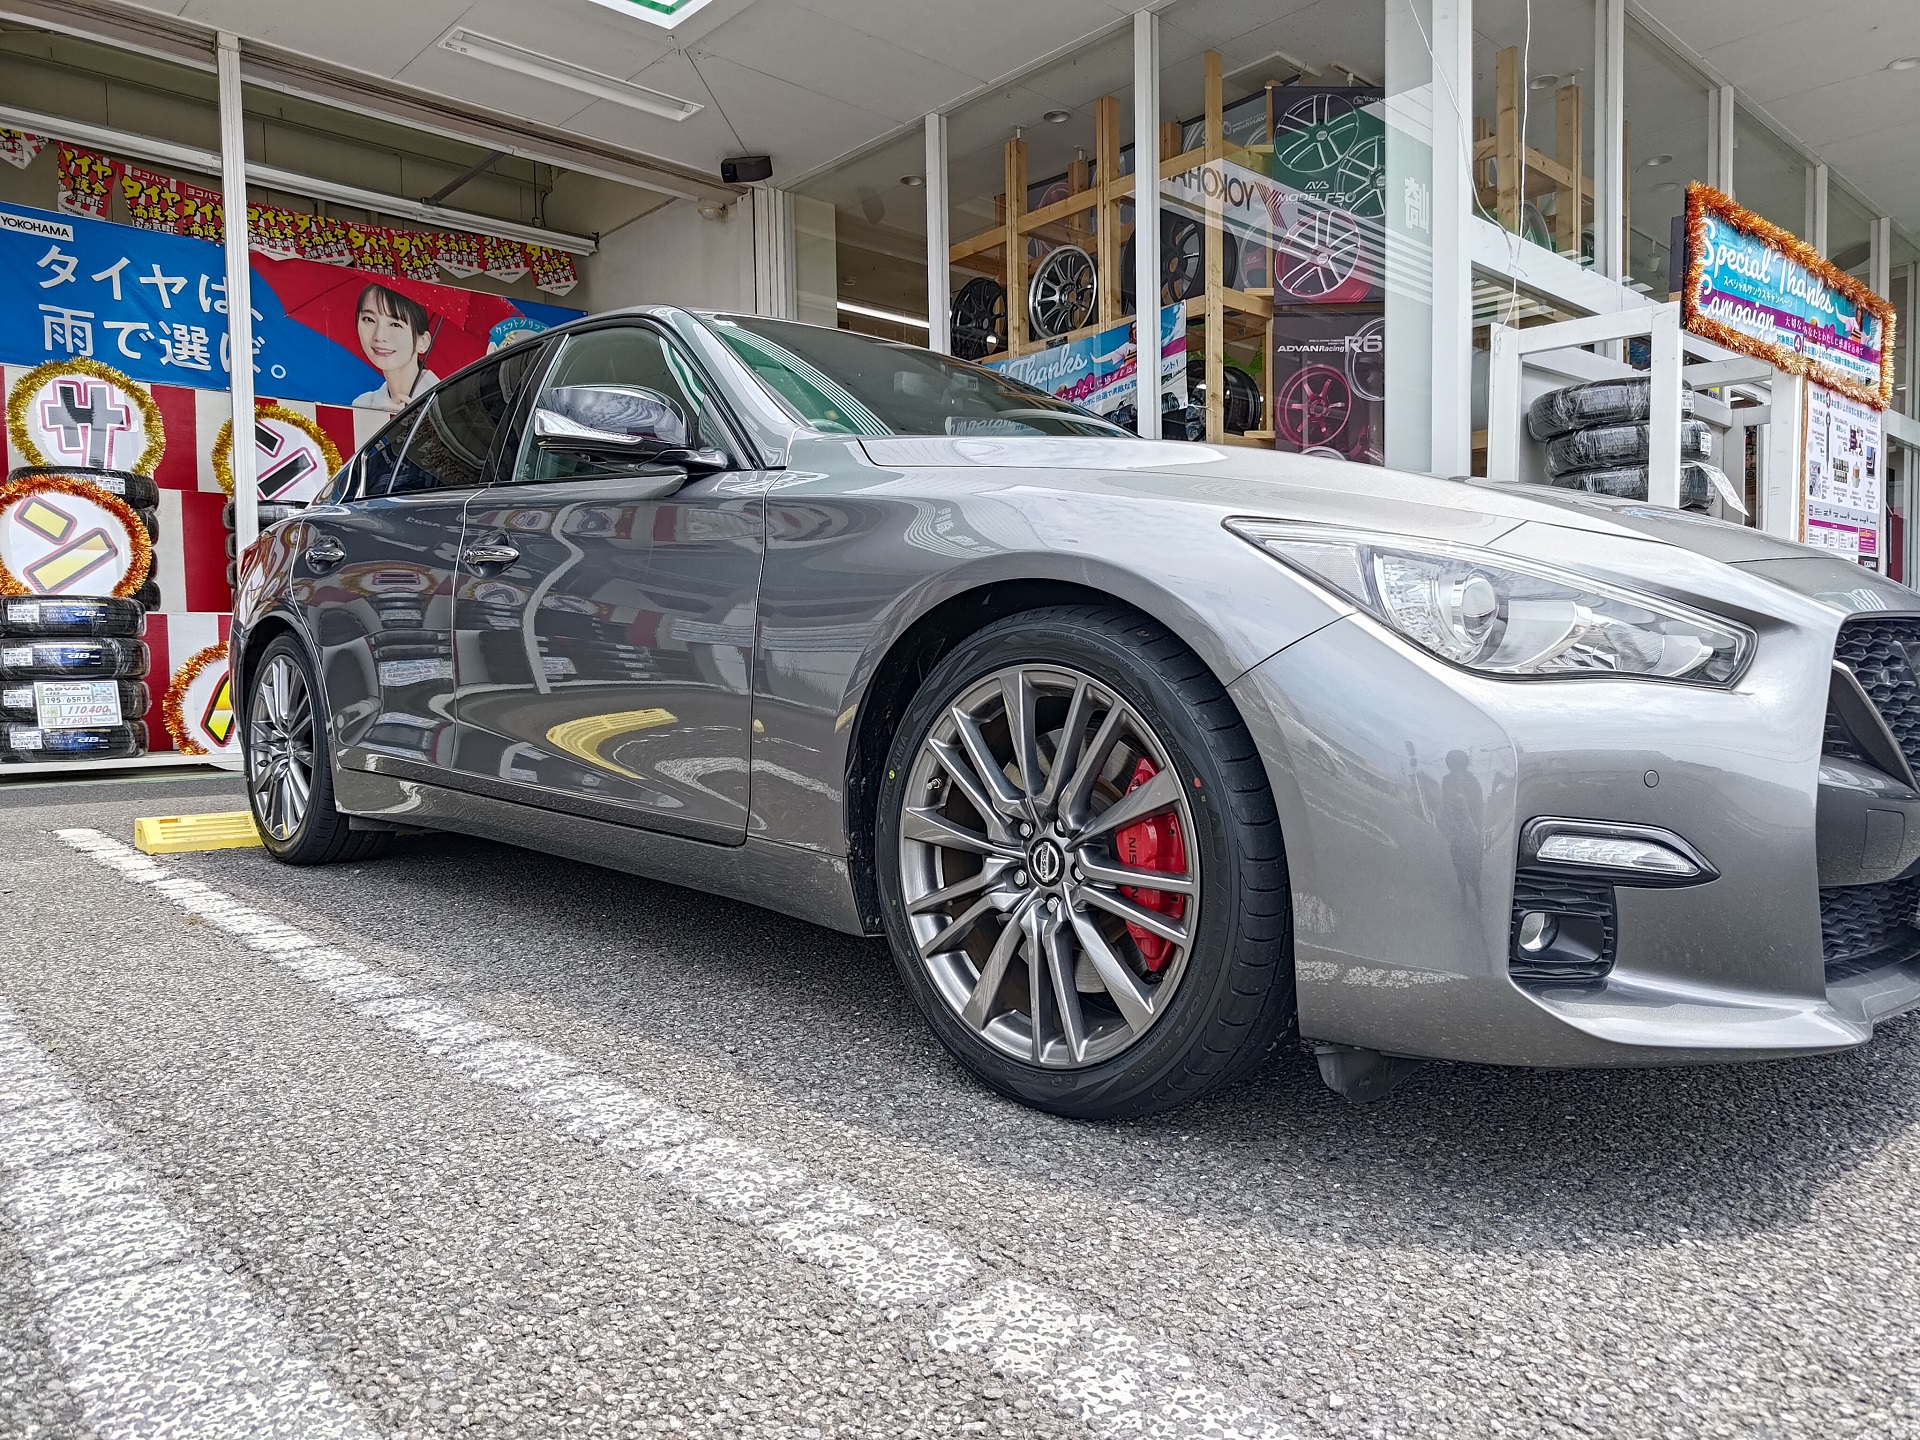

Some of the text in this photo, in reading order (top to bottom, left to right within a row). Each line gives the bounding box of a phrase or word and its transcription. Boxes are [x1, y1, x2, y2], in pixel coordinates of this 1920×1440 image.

[121, 174, 182, 207] タイヤ
[1276, 191, 1357, 204] MODEL F50
[0, 215, 70, 238] YOKOHAMA
[1699, 217, 1835, 314] Special Thanks
[1698, 274, 1776, 338] Campaign
[1344, 335, 1383, 353] R6
[1009, 343, 1087, 387] Thanks
[1038, 842, 1051, 883] NISSAN
